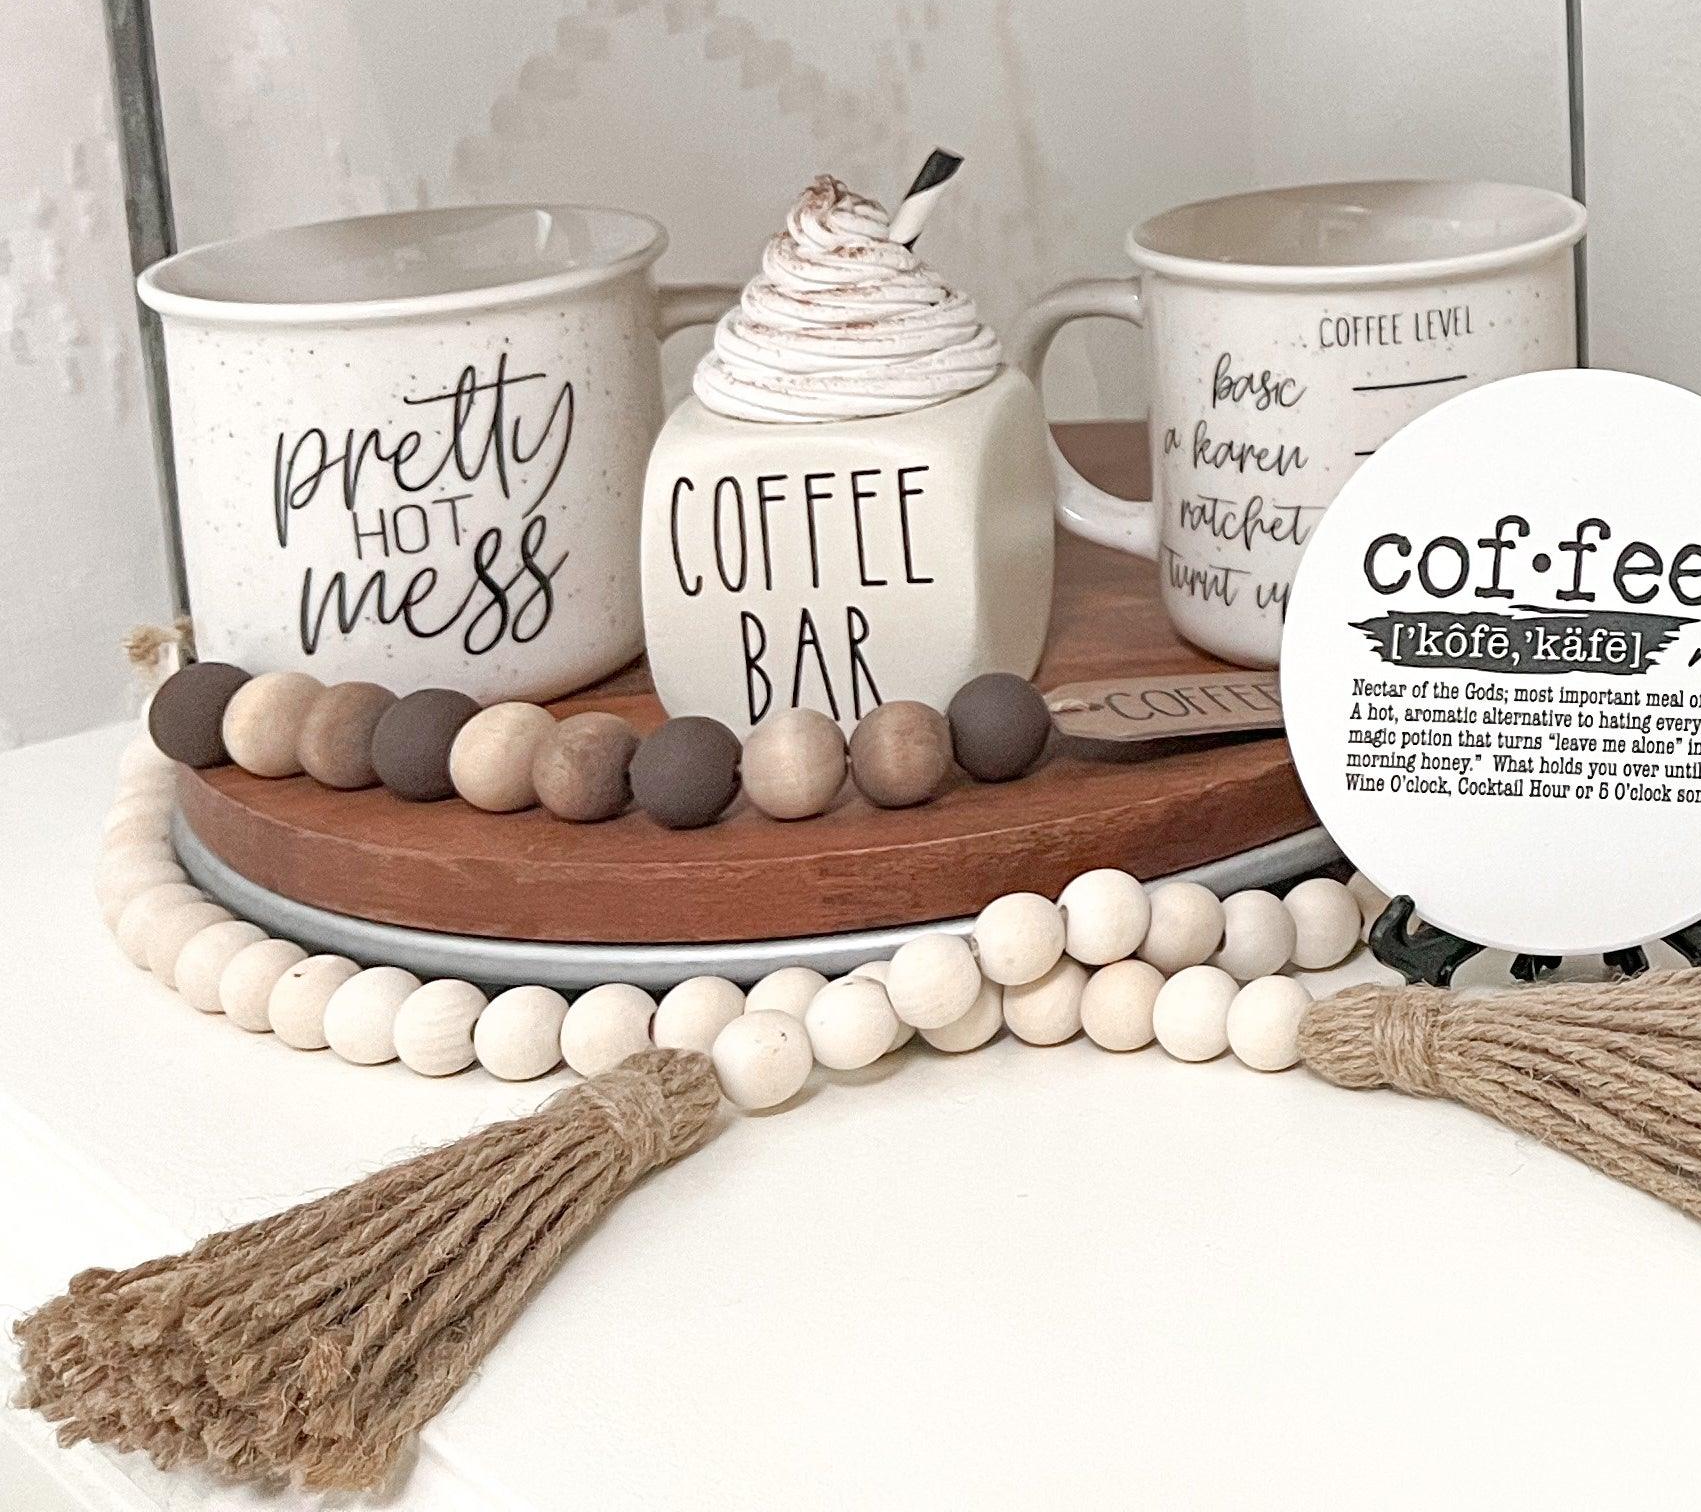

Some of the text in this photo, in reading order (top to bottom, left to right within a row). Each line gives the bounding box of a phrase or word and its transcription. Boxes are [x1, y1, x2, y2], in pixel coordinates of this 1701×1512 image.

[1320, 305, 1475, 348] COFFEE LEVEL
[1212, 352, 1307, 410] basic
[273, 352, 574, 549] pretty
[1164, 419, 1309, 476] a karen
[351, 493, 473, 560] HOT
[670, 465, 935, 597] COFFEE
[1180, 494, 1326, 551] ratchet
[300, 514, 569, 656] mess
[1161, 541, 1251, 607] turnt
[740, 605, 883, 725] BAR
[1351, 678, 1408, 698] Nectar
[1411, 680, 1430, 699] of
[1433, 681, 1460, 700] the
[1465, 682, 1509, 705] Gods;
[1513, 686, 1554, 703] most
[1558, 686, 1641, 708] important
[1645, 689, 1684, 708] meal
[1347, 727, 1397, 749] magic
[1400, 728, 1453, 750] potion
[1458, 729, 1492, 749] that
[1497, 731, 1543, 750] turns
[1601, 738, 1626, 754] me
[1349, 701, 1363, 720] A
[1367, 702, 1399, 725] hot,
[1404, 706, 1478, 724] aromatic
[1482, 706, 1573, 728] alternative
[1577, 710, 1594, 728] to
[1598, 710, 1652, 735] hating
[1345, 772, 1385, 792] Wine
[1390, 774, 1452, 797] O'clock,
[1457, 776, 1524, 797] Cocktail
[1528, 779, 1571, 799] Hour
[1575, 785, 1594, 800] or
[1614, 782, 1672, 803] O'clock
[1346, 751, 1417, 774] morning
[1492, 754, 1535, 774] What
[1538, 755, 1583, 776] holds
[1587, 762, 1618, 780] you
[1622, 763, 1660, 778] over
